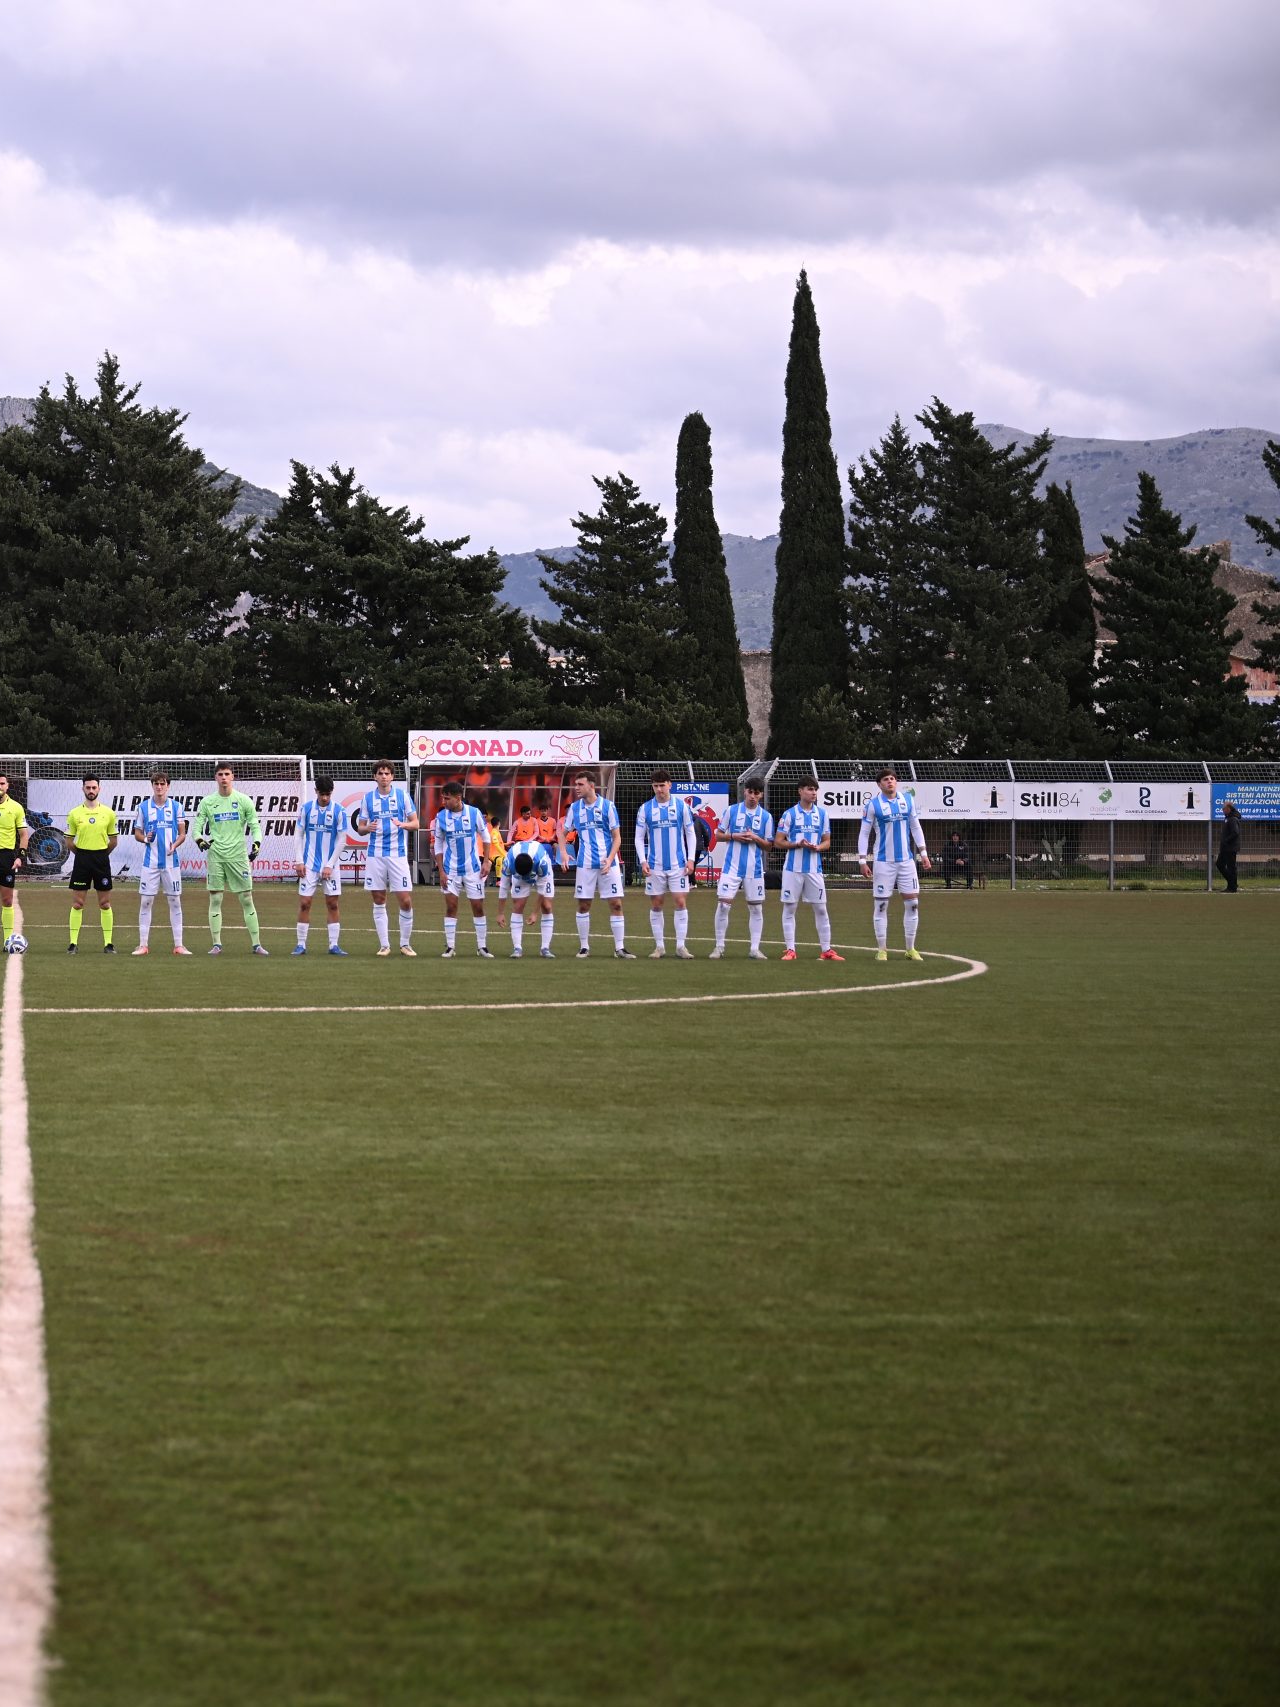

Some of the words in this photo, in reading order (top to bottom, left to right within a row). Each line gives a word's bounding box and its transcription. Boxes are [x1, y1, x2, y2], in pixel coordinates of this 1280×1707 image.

[436, 739, 523, 757] CONAD
[524, 749, 544, 757] CITY
[824, 790, 880, 806] Still8
[1020, 791, 1080, 807] Still84
[111, 796, 125, 811] IL
[268, 796, 299, 812] PER
[331, 880, 337, 891] 3
[402, 876, 408, 887] 6
[680, 878, 685, 888] 9
[476, 884, 482, 895] 4
[545, 882, 551, 894] 8
[611, 883, 617, 894] 5
[757, 885, 763, 896] 2
